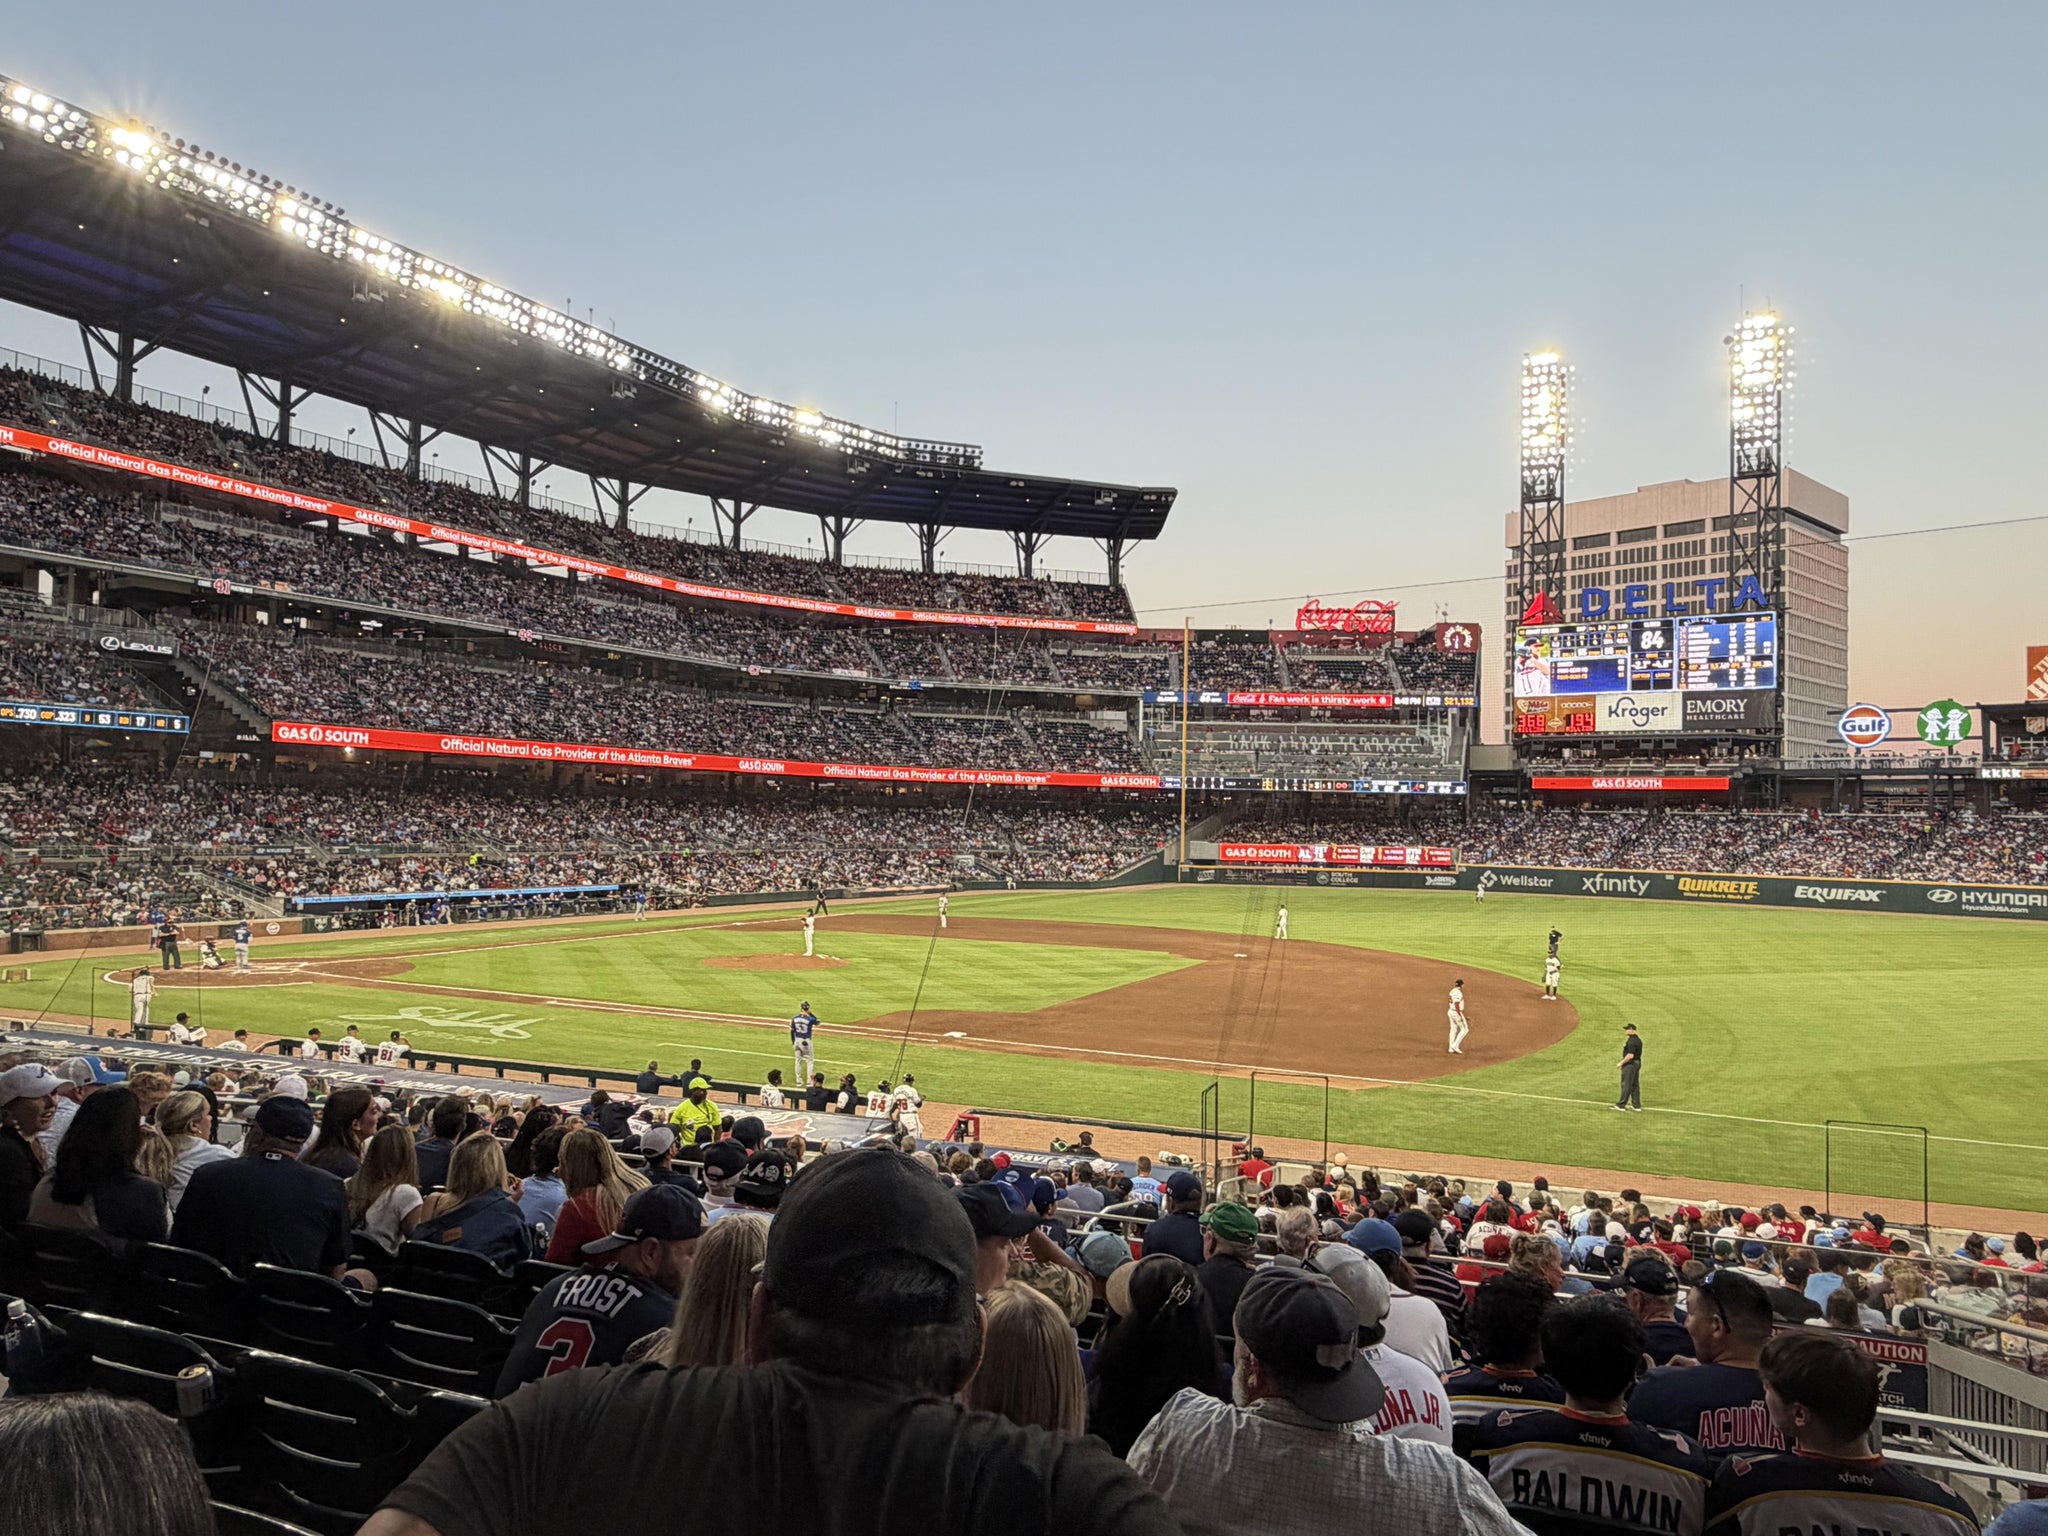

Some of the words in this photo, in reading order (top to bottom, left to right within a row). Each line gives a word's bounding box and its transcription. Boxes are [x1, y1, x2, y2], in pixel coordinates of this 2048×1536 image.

[48, 440, 95, 459] Official
[97, 451, 145, 471] Natural
[146, 463, 170, 476] Gas
[172, 467, 220, 488] Provider
[221, 480, 232, 490] of
[234, 483, 252, 494] the
[254, 487, 293, 504] Atlanta
[355, 510, 373, 522] GAS
[382, 516, 410, 530] SOUTH
[430, 526, 460, 544] Official
[461, 533, 491, 549] Natural
[491, 541, 506, 551] Gas
[507, 544, 538, 559] Provider
[538, 551, 547, 560] of
[547, 554, 558, 562] the
[559, 556, 584, 569] Atlanta
[213, 578, 231, 595] 41
[1582, 575, 1769, 617] DELTA
[1641, 630, 1664, 649] 84
[121, 642, 173, 655] LEXUS
[1268, 694, 1285, 703] Fan
[1287, 694, 1309, 703] work
[1311, 694, 1319, 703] is
[1320, 694, 1351, 706] thirsty
[1352, 696, 1377, 704] work
[1686, 698, 1748, 713] EMORY
[98, 713, 111, 725] 53
[1518, 714, 1545, 727] 368
[1570, 713, 1594, 727] 194
[1608, 697, 1668, 728] Kroger
[1686, 713, 1745, 721] HEALTHCARE
[136, 716, 146, 727] 17
[1841, 718, 1886, 733] Gulf
[278, 726, 307, 740] GAS
[324, 729, 369, 744] SOUTH
[440, 738, 484, 752] Official
[486, 743, 529, 756] Natural
[531, 745, 553, 757] Gas
[554, 747, 596, 760] Provider
[599, 749, 609, 760] of
[610, 750, 626, 761] the
[627, 753, 661, 764] Atlanta
[1228, 734, 1271, 750] HANK
[1279, 735, 1335, 751] AARON
[1338, 736, 1419, 753] TERRACE
[738, 760, 754, 770] GAS
[761, 762, 785, 772] SOUTH
[823, 766, 856, 776] Official
[858, 767, 891, 778] Natural
[892, 769, 909, 779] Gas
[910, 769, 946, 780] Provider
[948, 771, 959, 780] of
[960, 772, 976, 781] the
[977, 773, 1013, 782] Atlanta
[1100, 776, 1119, 785] GAS
[1128, 777, 1157, 786] SOUTH
[1592, 778, 1614, 789] GAS
[1626, 778, 1663, 789] SOUTH
[1225, 847, 1246, 858] GAS
[1257, 848, 1292, 859] SOUTH
[1298, 848, 1312, 859] AL
[1500, 874, 1554, 888] Wellstar
[1581, 873, 1651, 896] xfinity
[1678, 877, 1759, 894] QUIKRETE
[1794, 885, 1881, 903] EQUIFAX
[1962, 891, 2048, 907] HYUNDAI
[1962, 904, 2029, 914] HyundaiUSA.com
[794, 1023, 809, 1034] 53
[380, 1050, 394, 1062] 81
[552, 1274, 644, 1318] FROST
[1859, 1340, 1923, 1362] AUTION
[1879, 1393, 1905, 1405] TCH
[1373, 1384, 1418, 1435] UÑA
[1420, 1390, 1443, 1431] JR.
[1700, 1401, 1786, 1451] ACUÑA
[1578, 1431, 1612, 1448] xfinity
[1838, 1471, 1874, 1487] xfinity
[1511, 1467, 1683, 1534] BALDWIN
